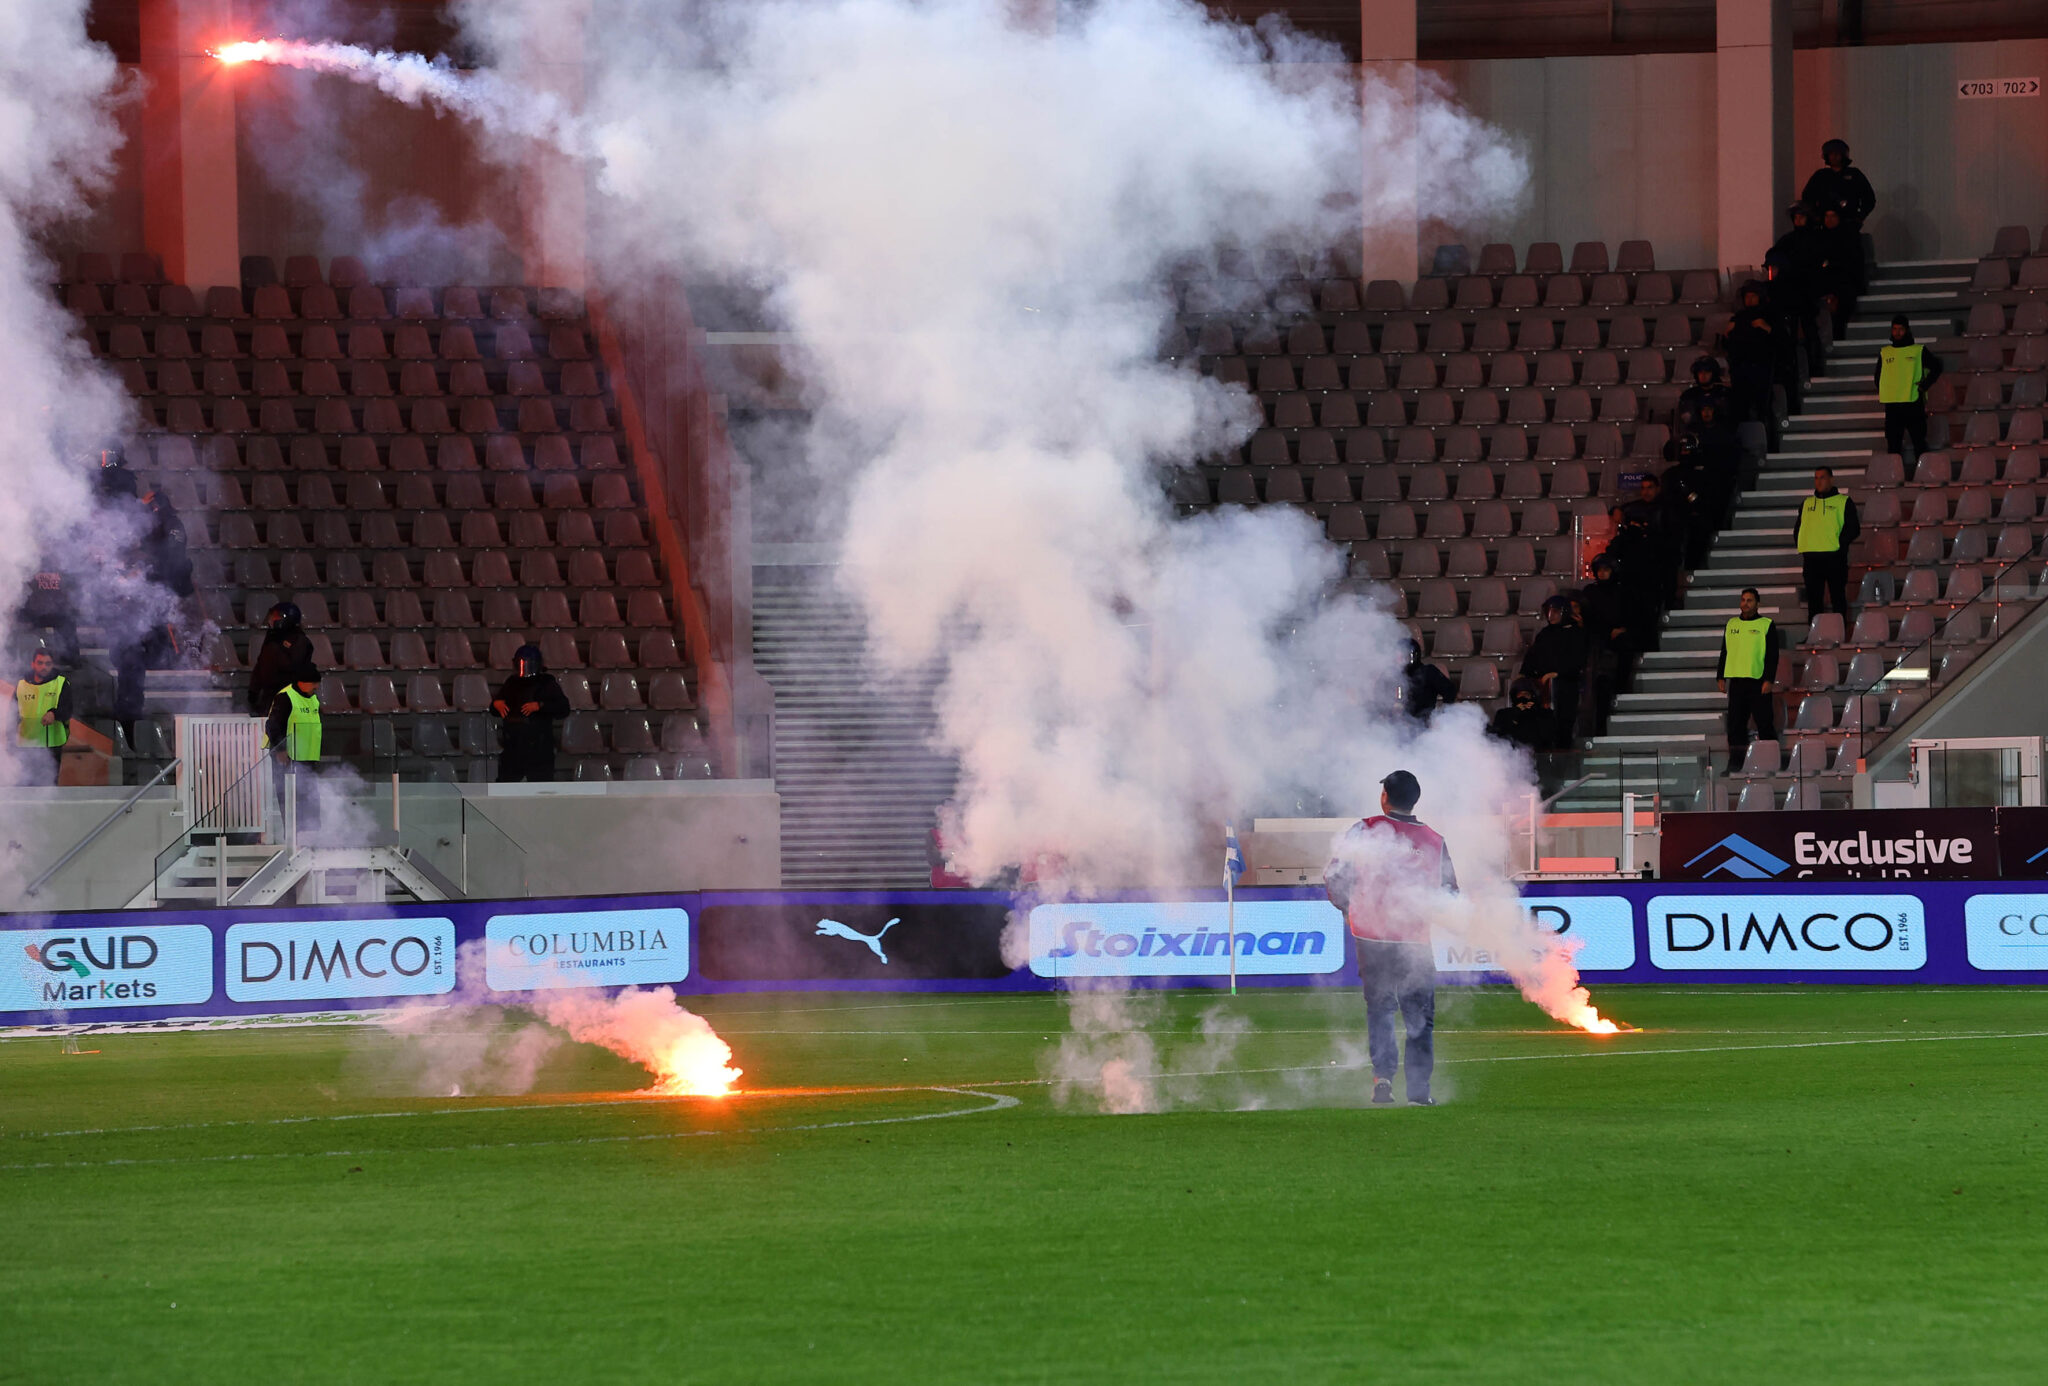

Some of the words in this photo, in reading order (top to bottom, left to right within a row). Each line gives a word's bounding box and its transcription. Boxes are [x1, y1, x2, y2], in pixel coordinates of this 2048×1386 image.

[1970, 83, 1993, 95] 703
[2003, 82, 2026, 94] 702
[1794, 830, 1973, 865] Exclusive
[1666, 912, 1893, 954] DIMCO
[1898, 912, 1908, 932] 1966
[434, 935, 442, 955] 1966
[508, 929, 668, 956] COLUMBIA
[1048, 921, 1325, 957] Stoiximan
[241, 936, 430, 983] DIMCO
[43, 979, 157, 1001] Markets
